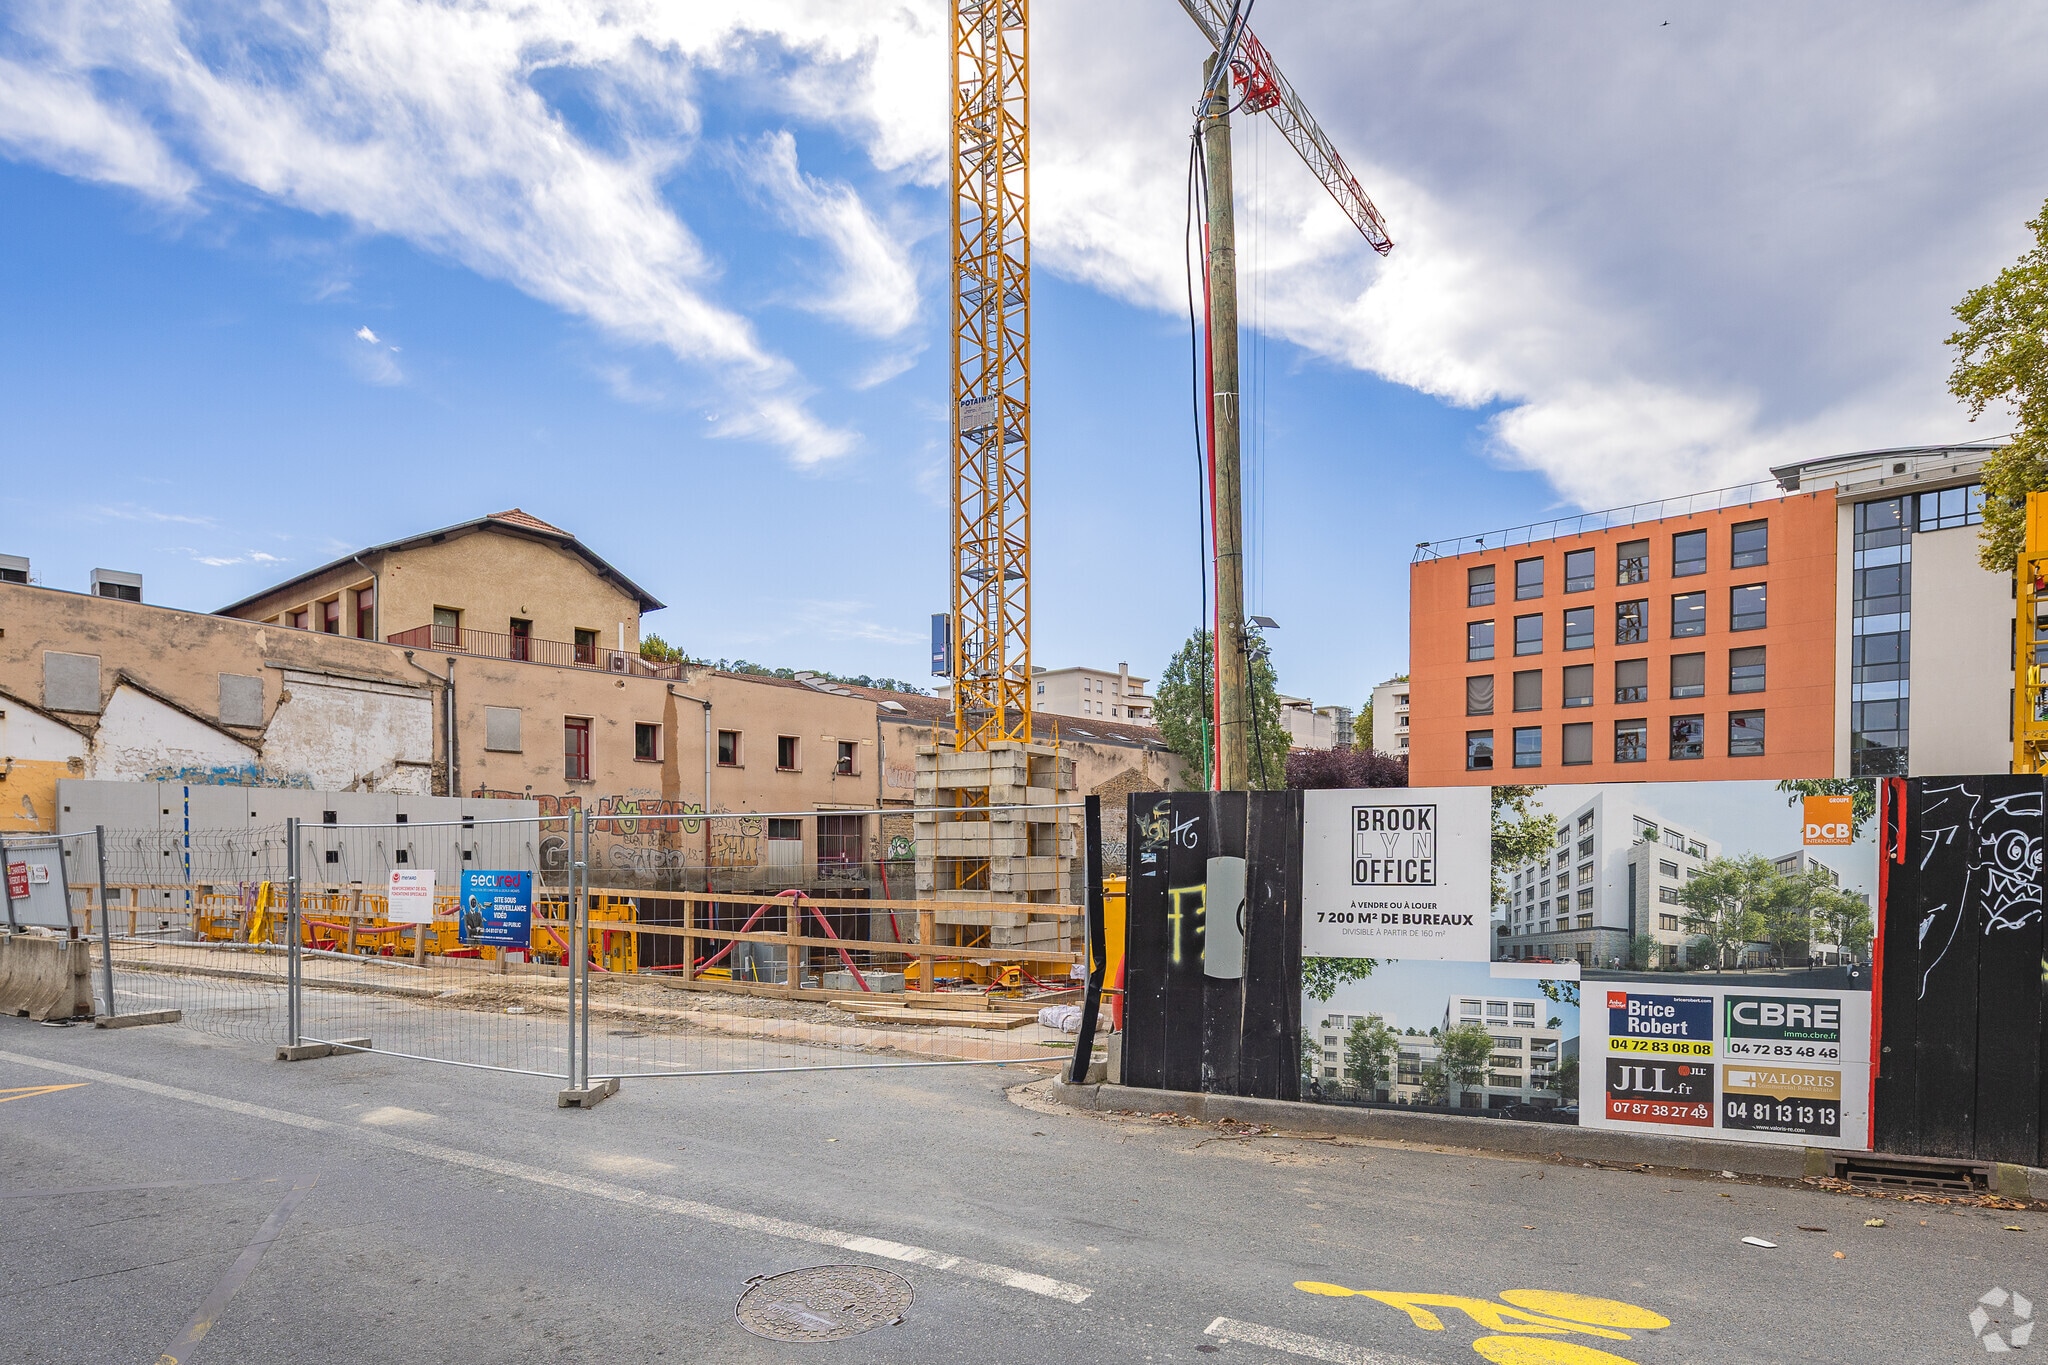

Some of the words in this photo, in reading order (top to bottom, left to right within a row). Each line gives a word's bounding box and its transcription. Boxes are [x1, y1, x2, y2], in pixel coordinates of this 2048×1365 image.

[961, 397, 986, 407] POTAIN
[1357, 808, 1432, 831] BROOK
[1806, 823, 1850, 838] DCB
[1356, 859, 1432, 883] OFFICE
[471, 873, 521, 887] secured
[494, 904, 527, 912] SURVEILLANCE
[1350, 900, 1356, 908] À
[1404, 901, 1410, 909] À
[494, 911, 507, 919] VIDÉO
[1317, 912, 1325, 923] 7
[1328, 912, 1354, 923] 200
[1381, 913, 1398, 924] DE
[1402, 914, 1474, 926] BUREAUX
[1342, 928, 1374, 936] DIVISIBLE
[1376, 927, 1382, 936] À
[1421, 929, 1433, 937] 160
[1628, 1000, 1675, 1018] Brice
[1732, 1002, 1839, 1029] CBRE
[1628, 1017, 1688, 1035] Robert
[1784, 1030, 1837, 1040] immo.cbre.fr
[1611, 1039, 1628, 1050] 04
[1631, 1040, 1648, 1051] 72
[1652, 1041, 1669, 1052] 83
[1672, 1043, 1690, 1054] 08
[1693, 1044, 1711, 1055] 08
[1732, 1043, 1750, 1053] 04
[1753, 1044, 1770, 1055] 72
[1774, 1046, 1792, 1056] 83
[1796, 1047, 1815, 1058] 48
[1818, 1048, 1838, 1058] 48
[1613, 1065, 1693, 1095] JLL.fr
[1758, 1072, 1835, 1088] VALORIS
[1613, 1102, 1630, 1113] 07
[1632, 1103, 1649, 1114] 87
[1652, 1104, 1668, 1116] 38
[1671, 1106, 1688, 1118] 27
[1690, 1108, 1708, 1119] 49
[1727, 1101, 1747, 1118] 04
[1753, 1103, 1770, 1120] 81
[1776, 1104, 1792, 1122] 13
[1797, 1106, 1814, 1123] 13
[1819, 1108, 1836, 1125] 13
[1755, 1124, 1806, 1133] www.valoris-re.com
